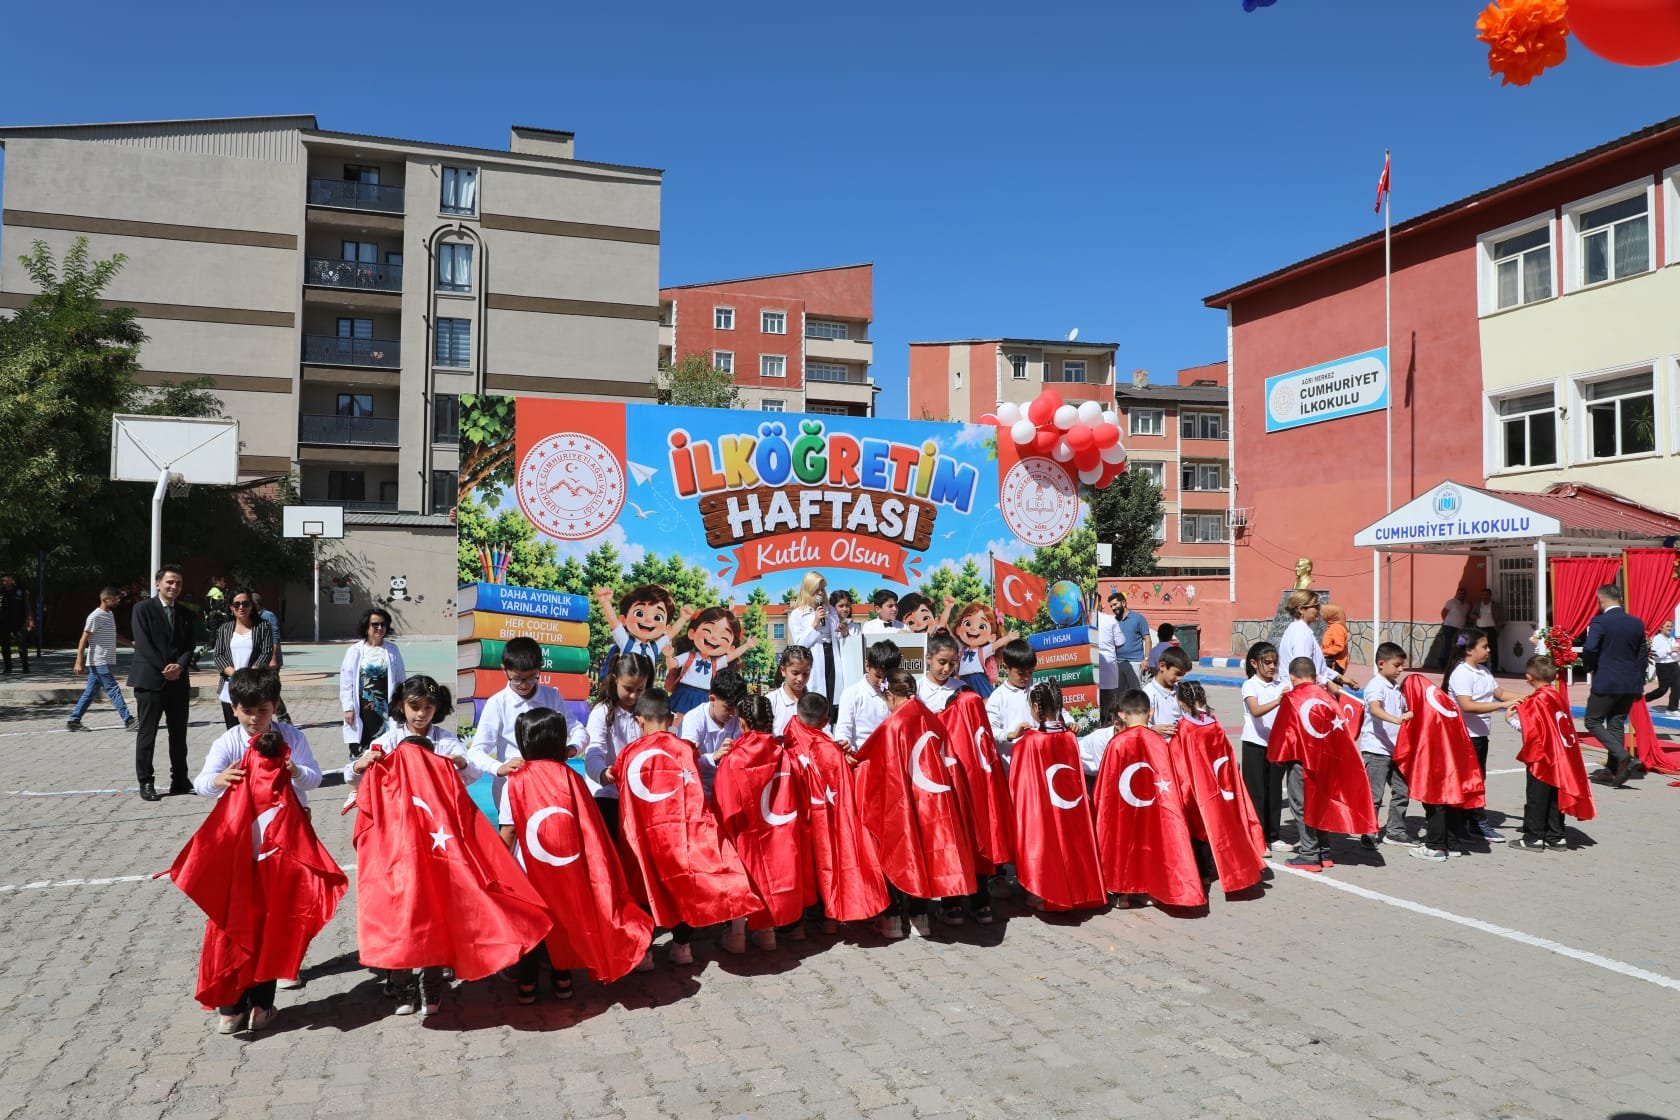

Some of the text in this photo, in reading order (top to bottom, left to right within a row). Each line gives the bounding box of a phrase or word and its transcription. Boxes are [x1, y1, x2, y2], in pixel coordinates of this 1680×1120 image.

[1300, 371, 1379, 399] CUMHURİYET
[1302, 371, 1335, 385] AĞRI MERKEZ
[1300, 391, 1360, 415] İLKOKULU
[669, 420, 978, 513] İLKÖĞRETİM
[726, 489, 920, 542] HAFTASI
[1375, 517, 1530, 540] CUMHURİYET İLKOKULU
[757, 536, 891, 571] Kutlu Olsun
[500, 588, 572, 606] DAHA AYDINLIK
[501, 600, 569, 618] YARINLAR İÇİN
[500, 628, 515, 639] BİR
[505, 618, 559, 632] HER ÇOCUK
[1052, 633, 1071, 644] İNSAN
[1045, 652, 1078, 664] VATANDAŞ
[1061, 671, 1081, 681] BİREY
[1062, 693, 1086, 704] ELECEK
